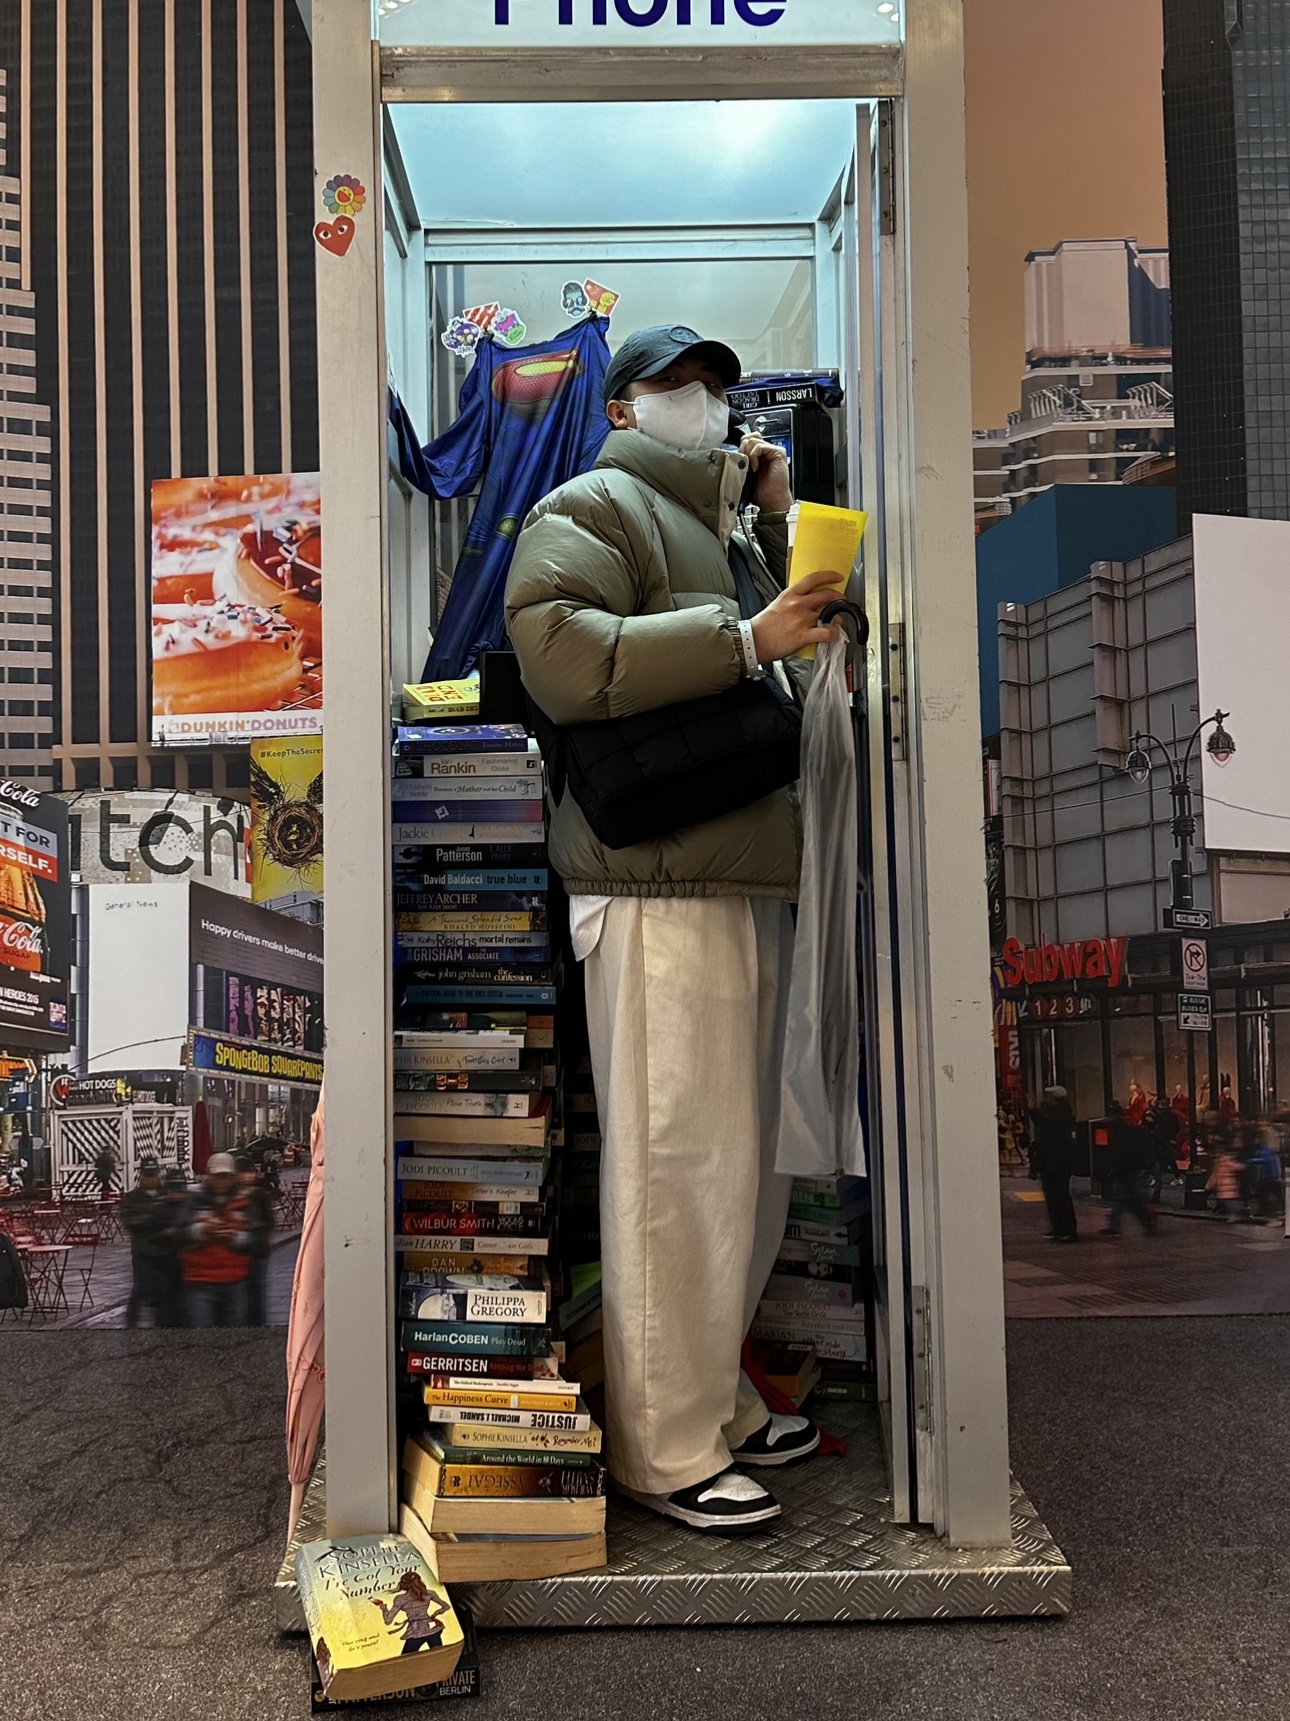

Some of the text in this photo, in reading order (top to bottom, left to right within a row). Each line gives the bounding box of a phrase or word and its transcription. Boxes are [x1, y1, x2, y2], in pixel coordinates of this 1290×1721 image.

[494, 0, 788, 28] one
[775, 387, 813, 402] LARSSON
[180, 716, 319, 734] DUNKIN' DONUTS
[430, 761, 477, 775] Rankin
[456, 784, 483, 793] Mother
[498, 784, 517, 793] Child
[15, 826, 51, 849] FOR
[397, 826, 430, 842] Jackie
[436, 848, 483, 862] Patterson
[423, 873, 528, 885] David Baldacci true blue
[397, 892, 478, 906] JEFFREY ARCHER
[428, 915, 437, 924] A
[470, 913, 502, 925] Splendid
[201, 918, 233, 939] Happy
[232, 929, 261, 946] drivers
[261, 938, 284, 953] make
[284, 943, 307, 960] better
[417, 932, 532, 948] Kathy Reichs mortal remains
[413, 948, 463, 962] GRISHAM
[467, 951, 500, 960] ASSOCIATE
[1002, 932, 1127, 988] Subway
[437, 967, 492, 980] john grisham
[493, 970, 533, 983] confession
[215, 1041, 324, 1080] SPONGEBOB SQUAREPANTS
[413, 1054, 451, 1065] KINSELLA
[78, 1080, 95, 1091] HOT
[94, 1078, 117, 1090] DOGS
[464, 1098, 483, 1107] Truth
[400, 1163, 425, 1175] JODI
[427, 1164, 469, 1176] PICOULT
[414, 1189, 454, 1198] PICOULT
[412, 1217, 495, 1230] WILBUR SMITH
[414, 1238, 458, 1249] HARRY
[431, 1258, 456, 1267] DAN
[473, 1293, 527, 1307] PHILIPPA
[470, 1304, 528, 1318] GREGORY
[413, 1331, 526, 1348] Harlan COBEN Play Dead
[751, 1329, 796, 1341] MARIAN
[422, 1356, 489, 1373] GERRITSEN
[431, 1392, 509, 1405] The Happiness Curve
[459, 1411, 486, 1421] SANDEL
[491, 1413, 521, 1424] MICHAEL
[530, 1412, 578, 1430] JUSTICE
[472, 1432, 497, 1443] SOPHIE
[495, 1432, 529, 1444] KINSELLA
[481, 1453, 506, 1463] Around
[505, 1454, 517, 1463] the
[516, 1455, 536, 1464] World
[535, 1456, 542, 1464] in
[549, 1456, 565, 1466] Days
[319, 1551, 421, 1578] KINSELLA
[353, 1568, 382, 1583] Got
[387, 1564, 422, 1576] Your
[340, 1580, 396, 1600] Number
[439, 1684, 472, 1697] BERLIN
